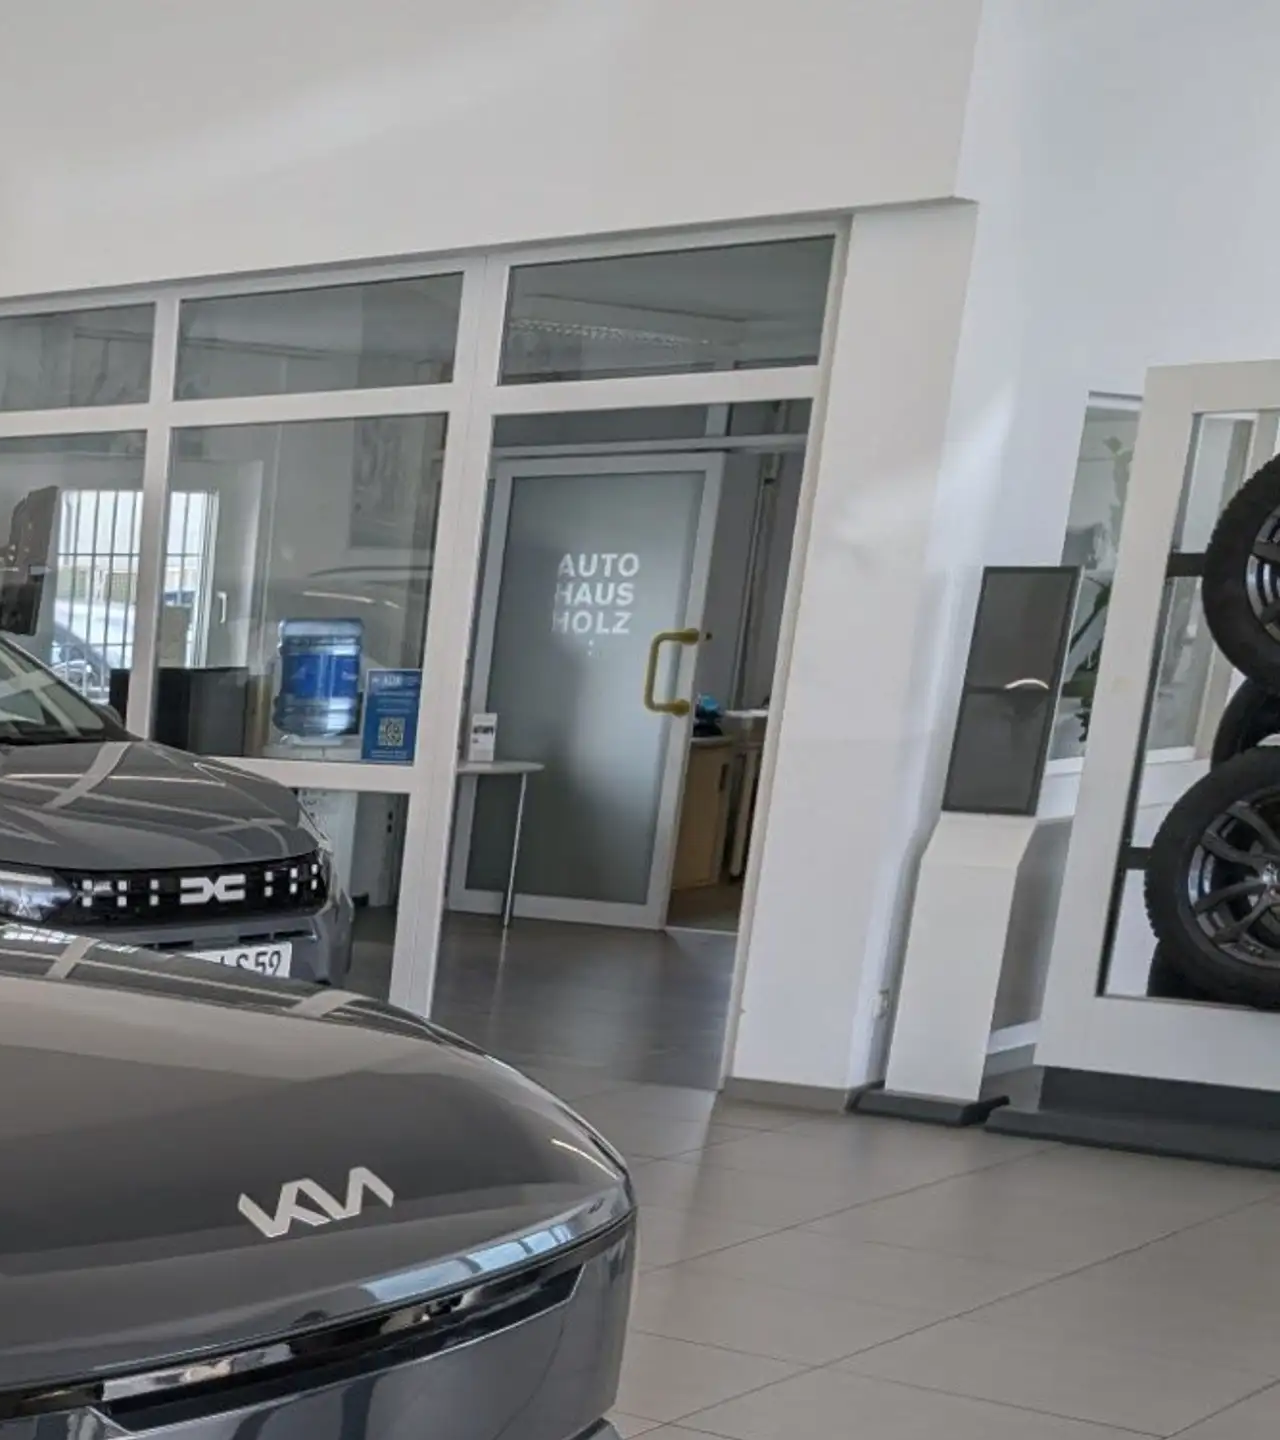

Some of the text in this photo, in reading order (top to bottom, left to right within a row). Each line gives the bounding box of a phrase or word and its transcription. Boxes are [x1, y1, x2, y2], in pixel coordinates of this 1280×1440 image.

[557, 552, 641, 578] AUTO
[553, 581, 636, 607] HAUS
[550, 609, 633, 635] HOLZ
[237, 1166, 395, 1238] KIA
